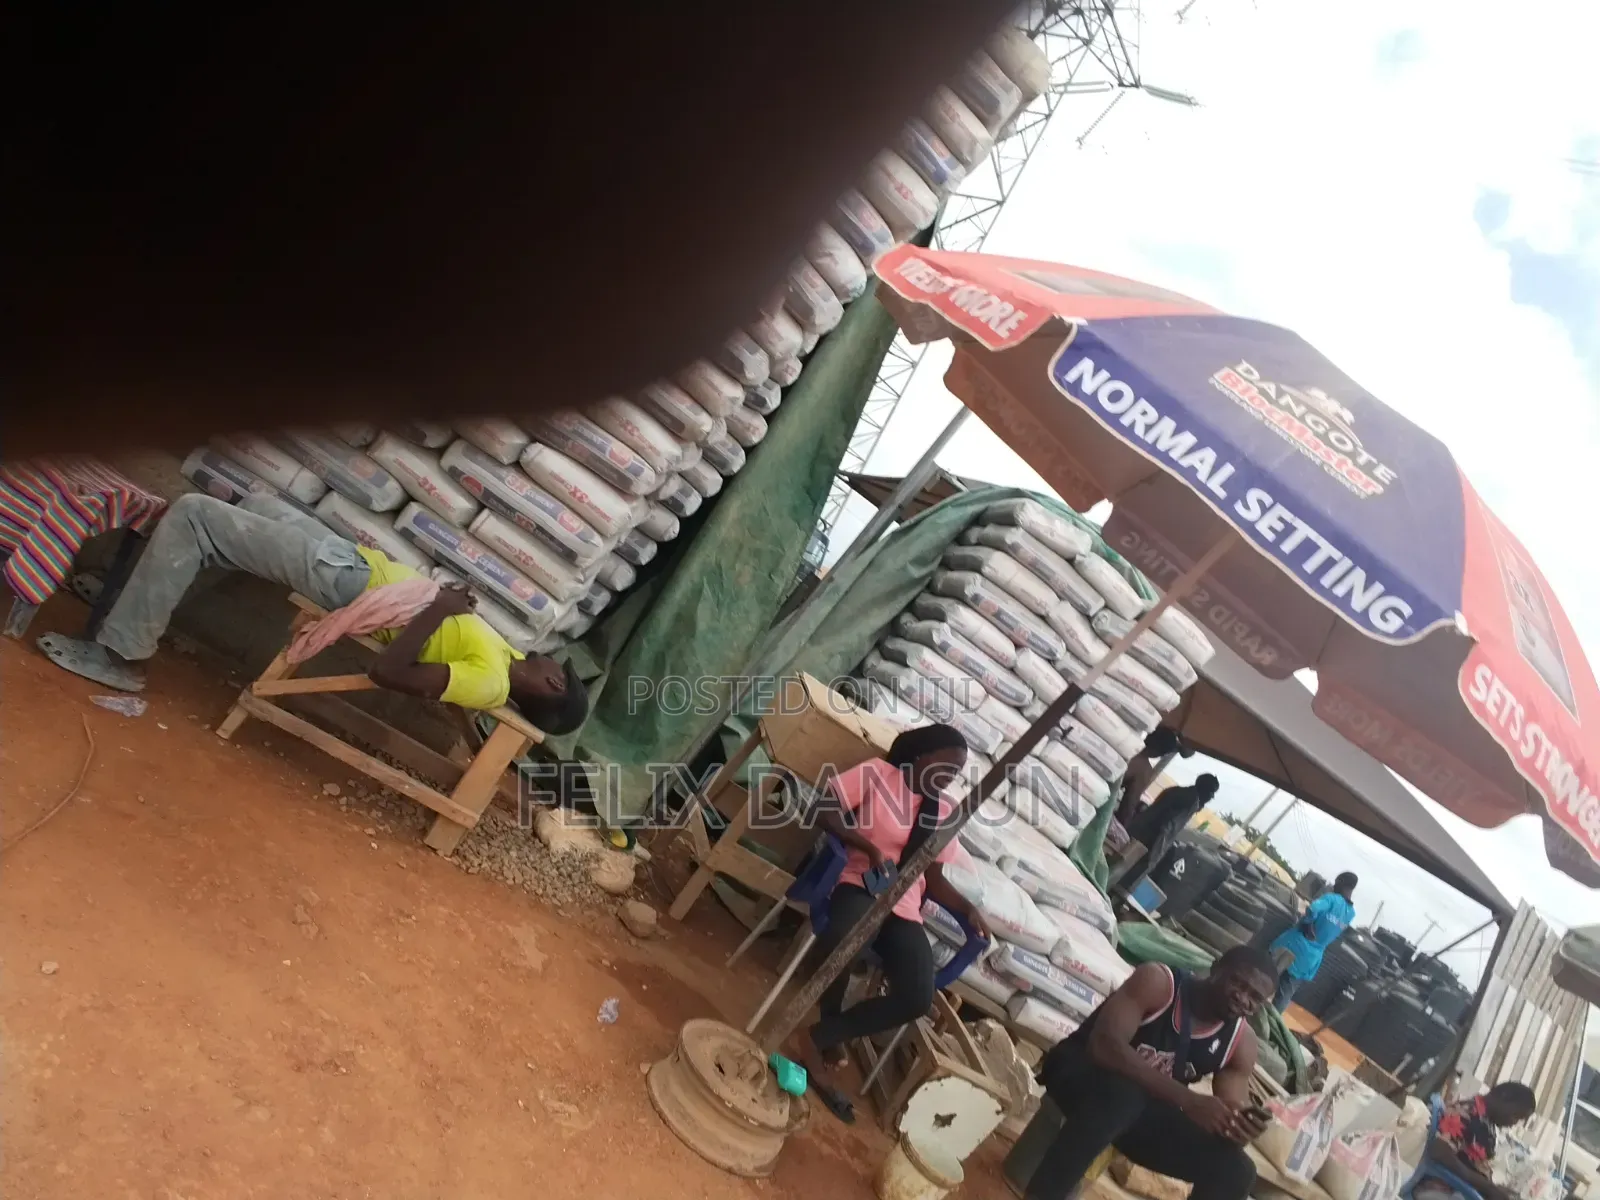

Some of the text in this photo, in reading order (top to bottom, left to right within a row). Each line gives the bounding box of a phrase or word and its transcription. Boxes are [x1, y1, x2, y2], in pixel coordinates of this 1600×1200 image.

[950, 273, 1028, 340] MORE
[1235, 359, 1398, 485] DANGOTE
[1064, 356, 1236, 499] NORMAL
[1234, 487, 1413, 634] SETTING
[1469, 664, 1526, 742] SETS
